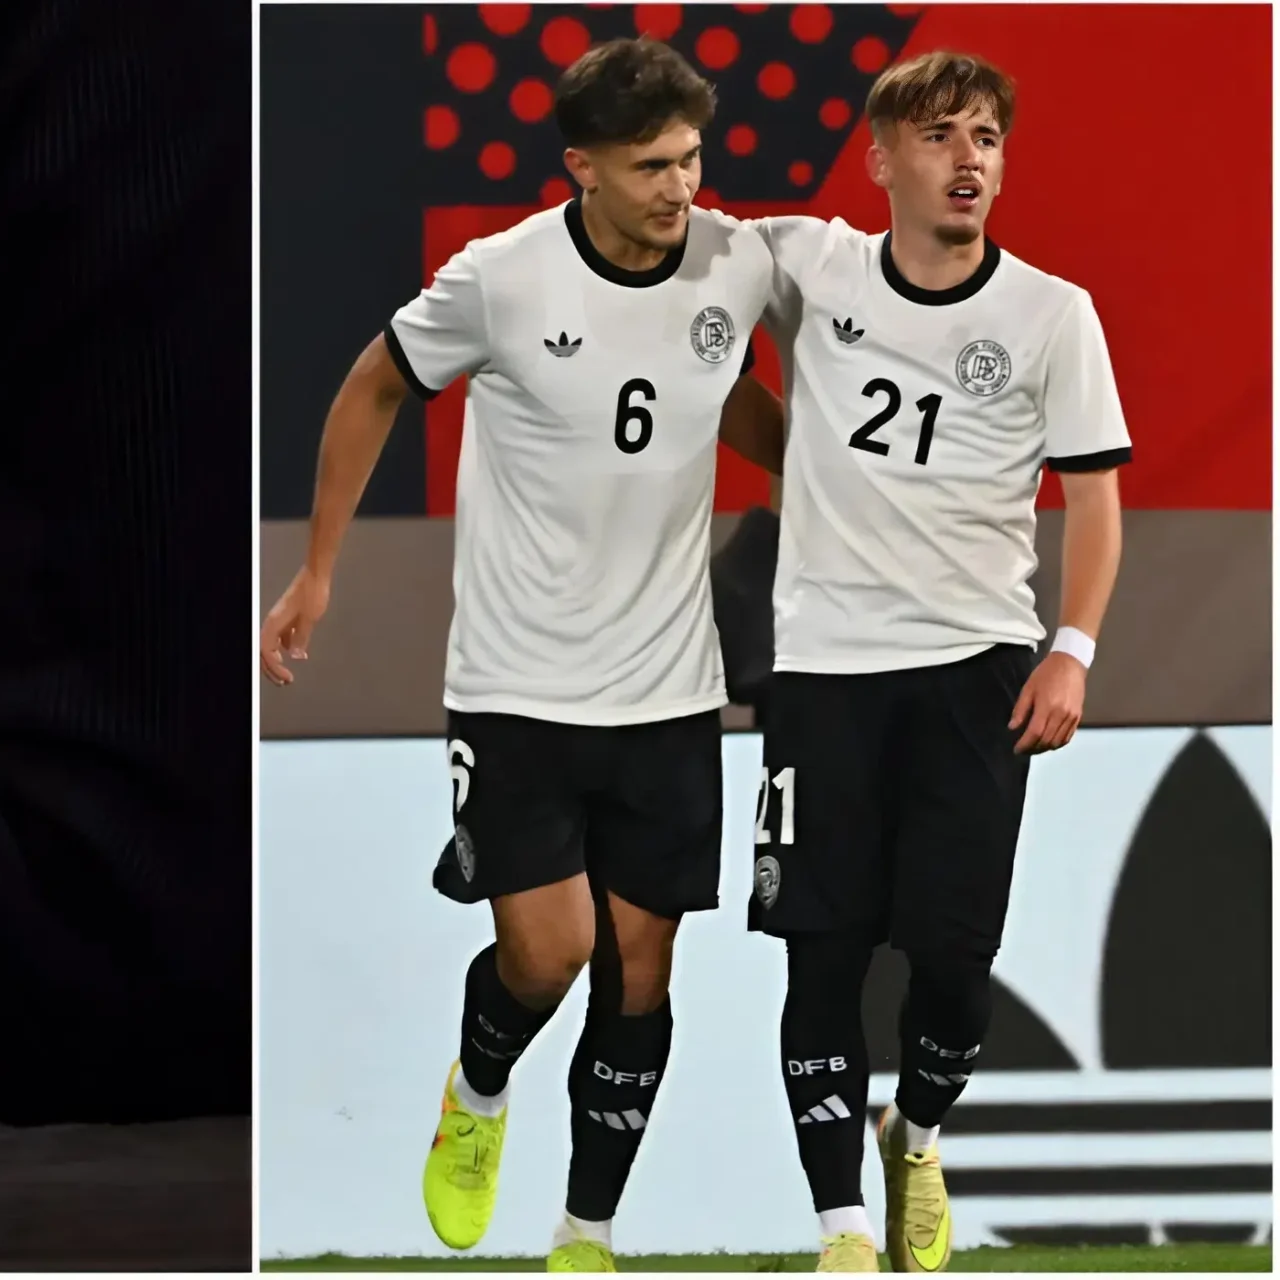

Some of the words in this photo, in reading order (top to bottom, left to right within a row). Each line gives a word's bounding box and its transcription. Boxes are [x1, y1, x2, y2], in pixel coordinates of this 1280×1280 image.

[614, 377, 656, 455] 6
[848, 377, 942, 466] 21
[593, 1060, 657, 1086] DFB
[788, 1056, 848, 1076] DFB
